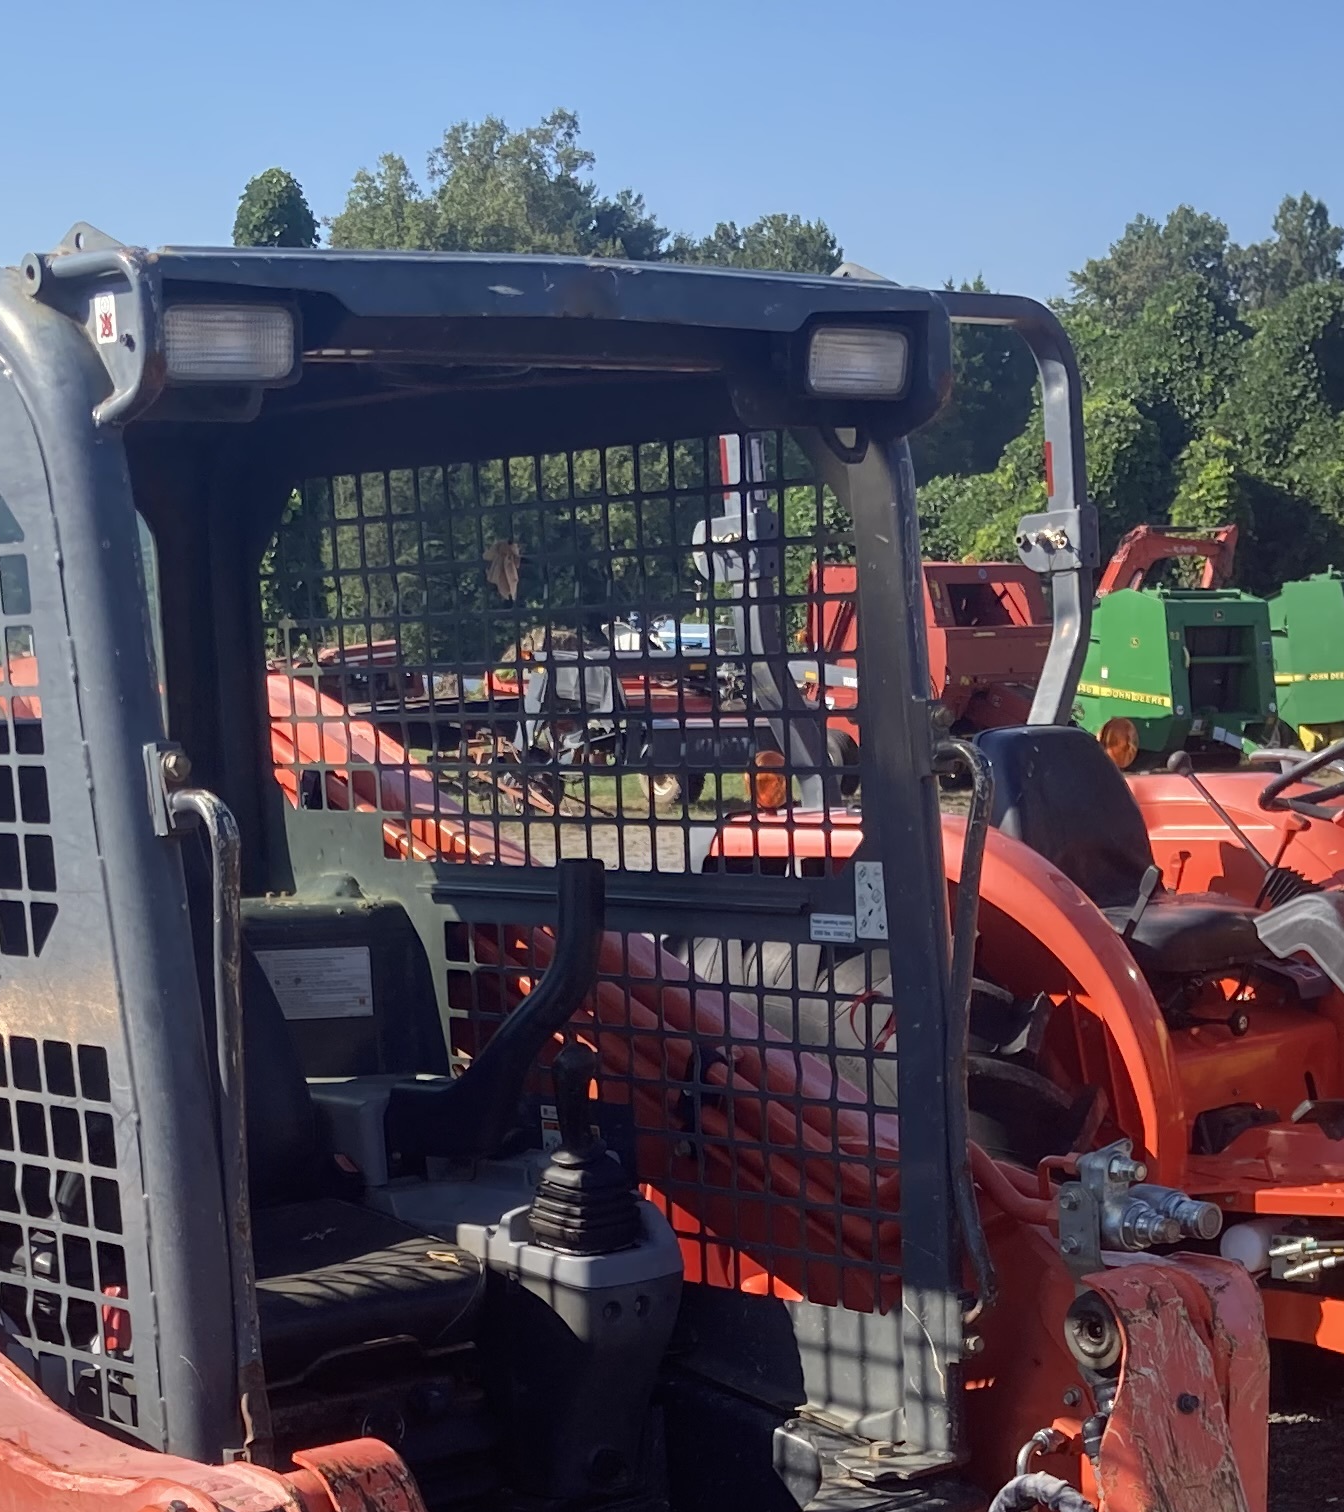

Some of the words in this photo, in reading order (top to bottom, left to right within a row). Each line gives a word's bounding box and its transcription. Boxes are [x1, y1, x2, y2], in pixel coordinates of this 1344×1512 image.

[1309, 672, 1329, 681] JOHN
[1106, 688, 1132, 700] JOHN
[1133, 692, 1164, 706] DEERE
